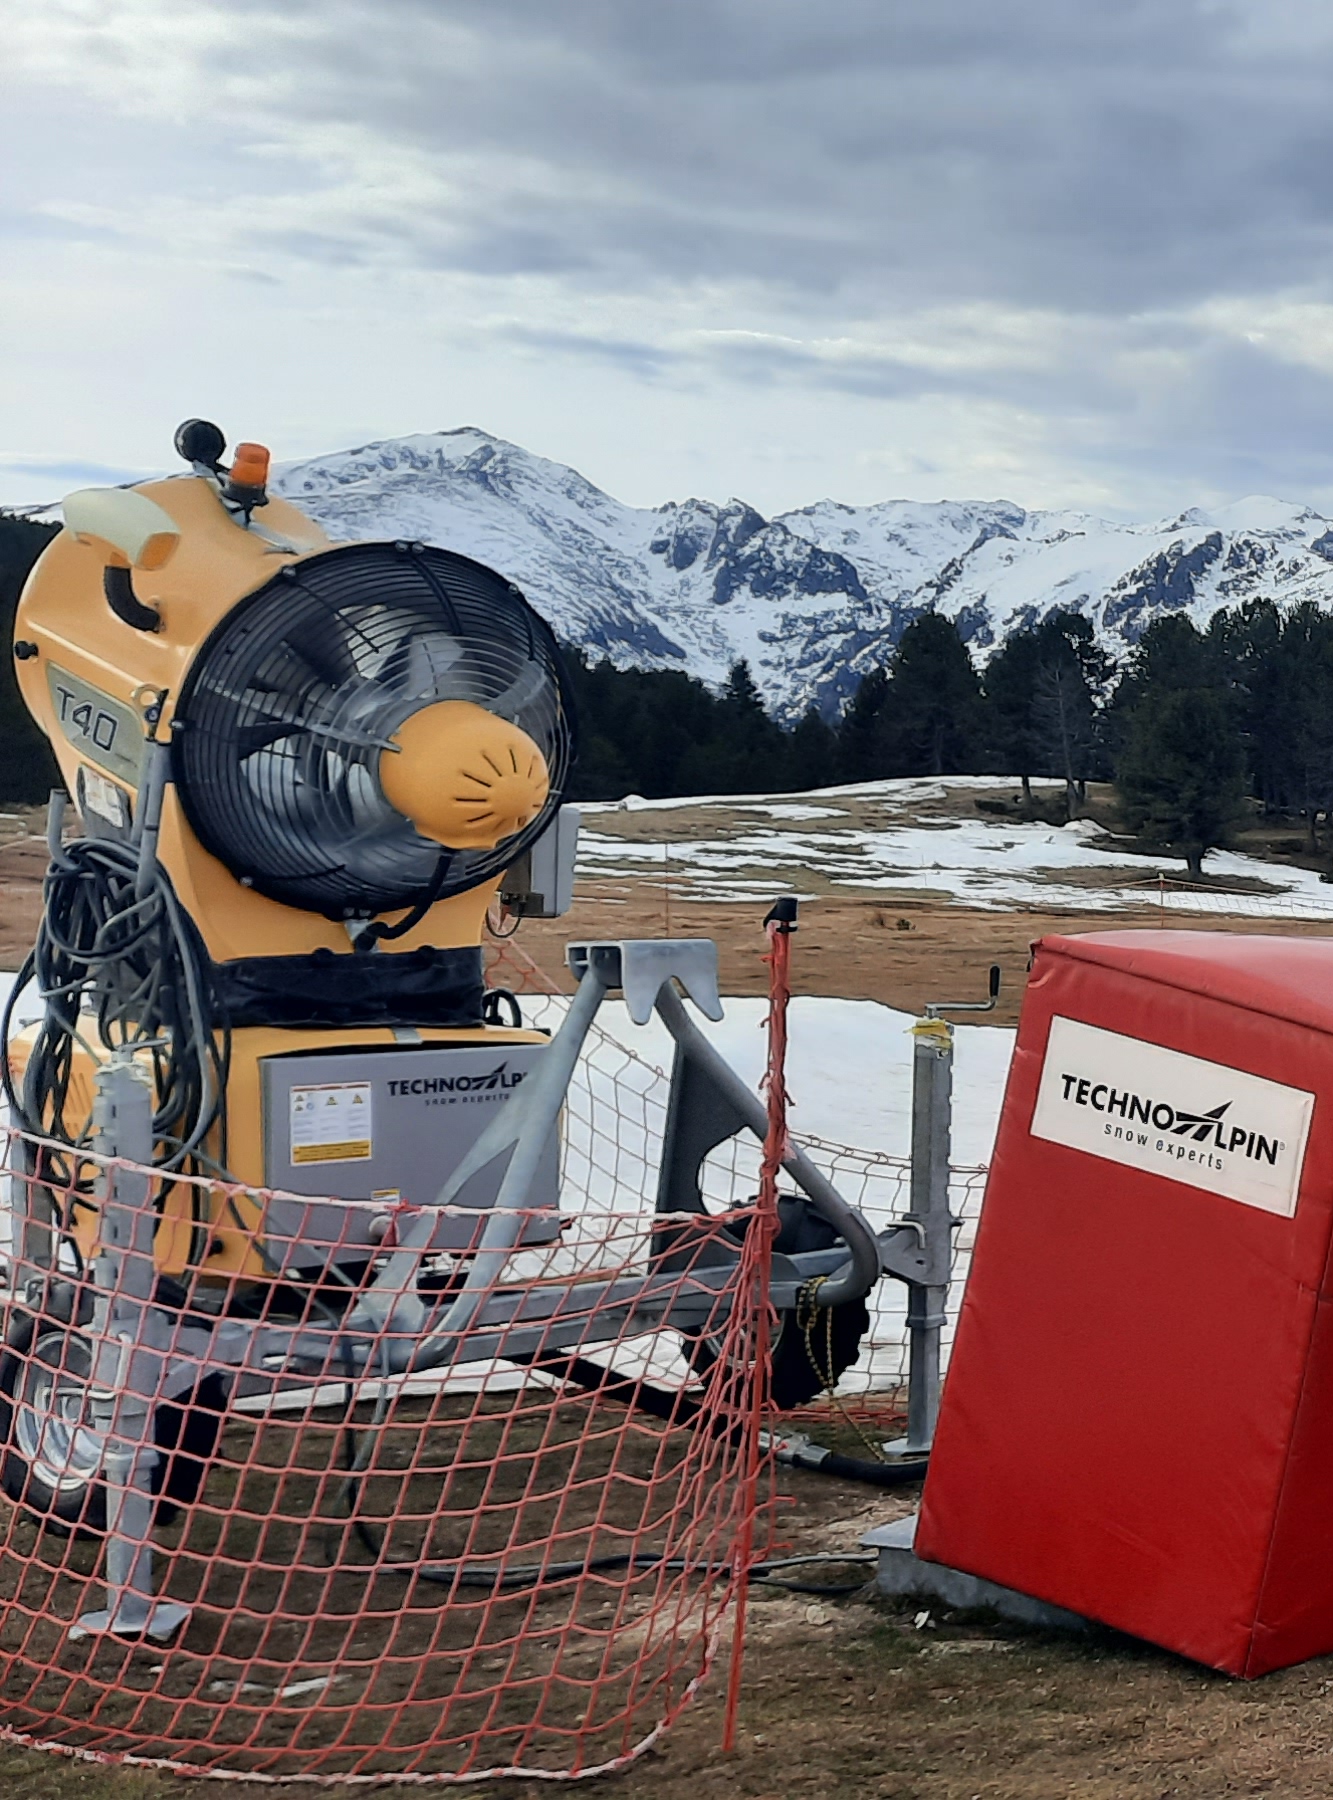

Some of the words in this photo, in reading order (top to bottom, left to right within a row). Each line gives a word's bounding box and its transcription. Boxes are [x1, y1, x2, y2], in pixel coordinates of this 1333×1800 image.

[56, 685, 117, 751] T40
[387, 1061, 528, 1096] TECHNOALP
[1104, 1122, 1148, 1147] snow
[1155, 1139, 1224, 1171] experts
